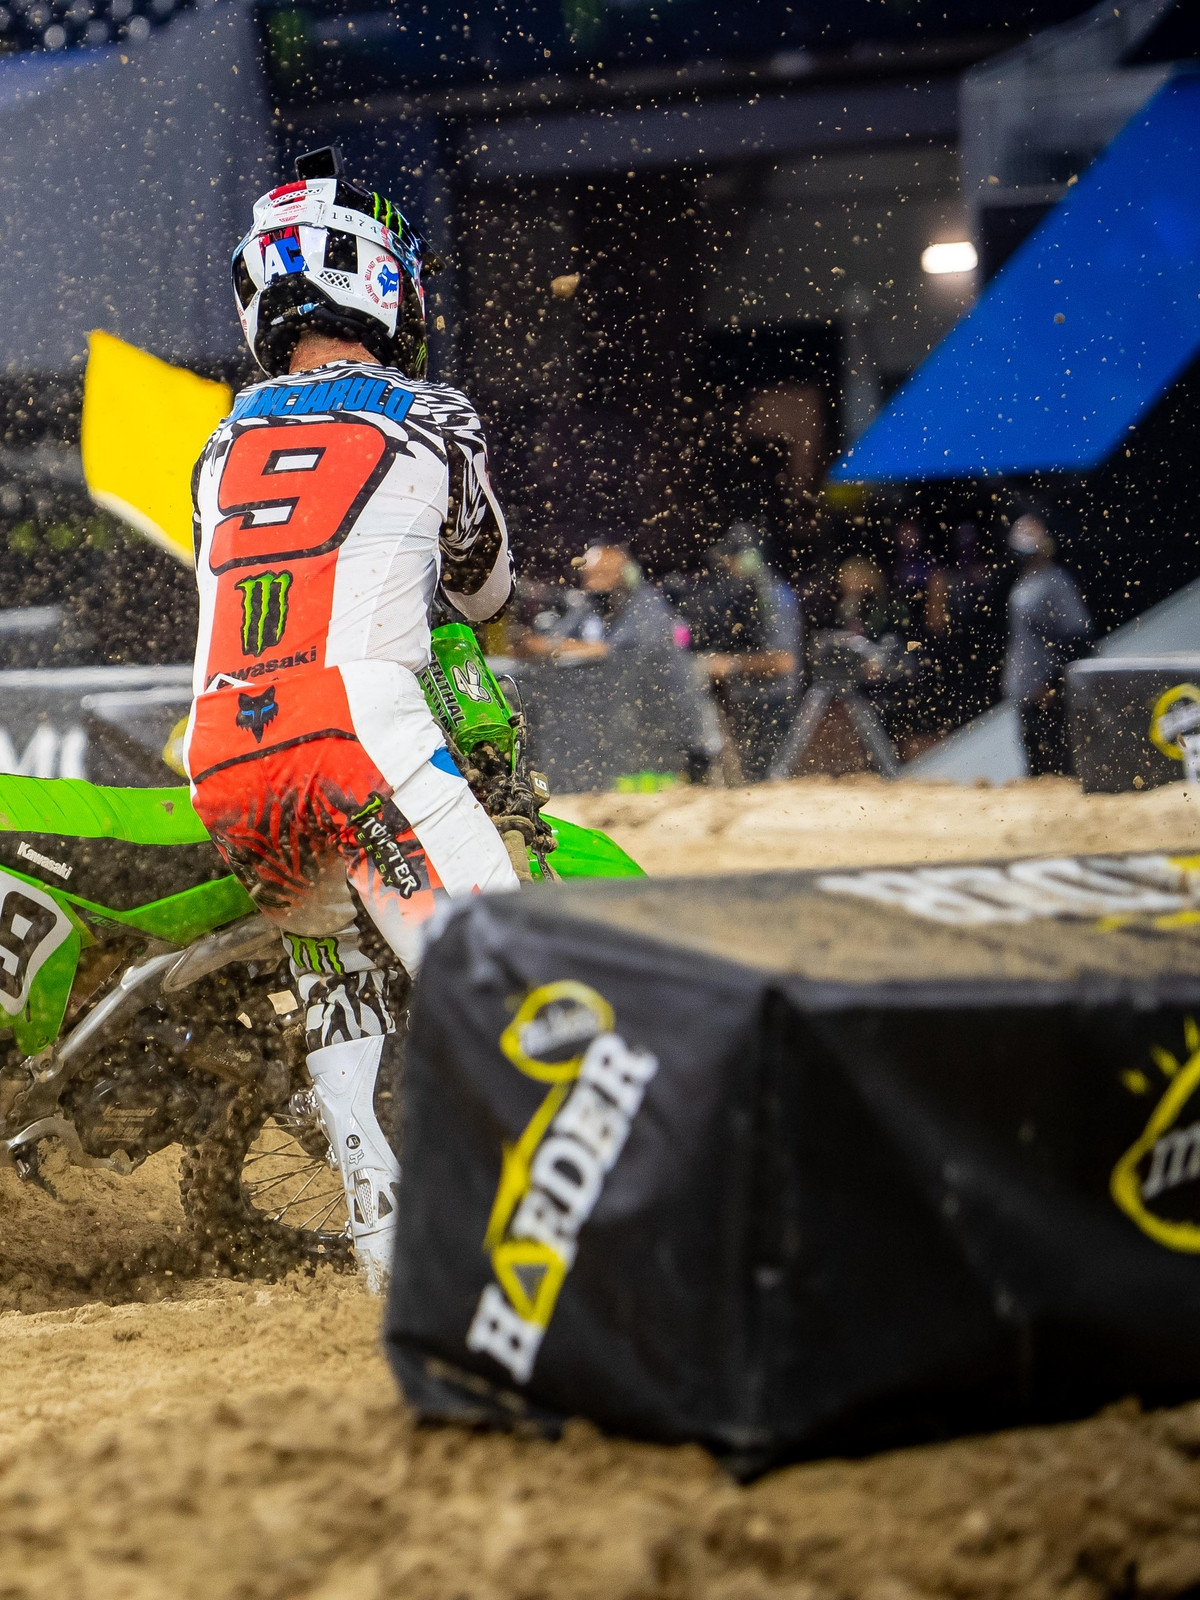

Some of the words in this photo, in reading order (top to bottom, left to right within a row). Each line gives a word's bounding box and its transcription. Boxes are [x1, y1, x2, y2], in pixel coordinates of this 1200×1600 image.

[209, 422, 392, 576] 9
[206, 646, 317, 690] Kwasaki
[17, 841, 73, 881] Kawasaki
[357, 832, 393, 887] EERGY
